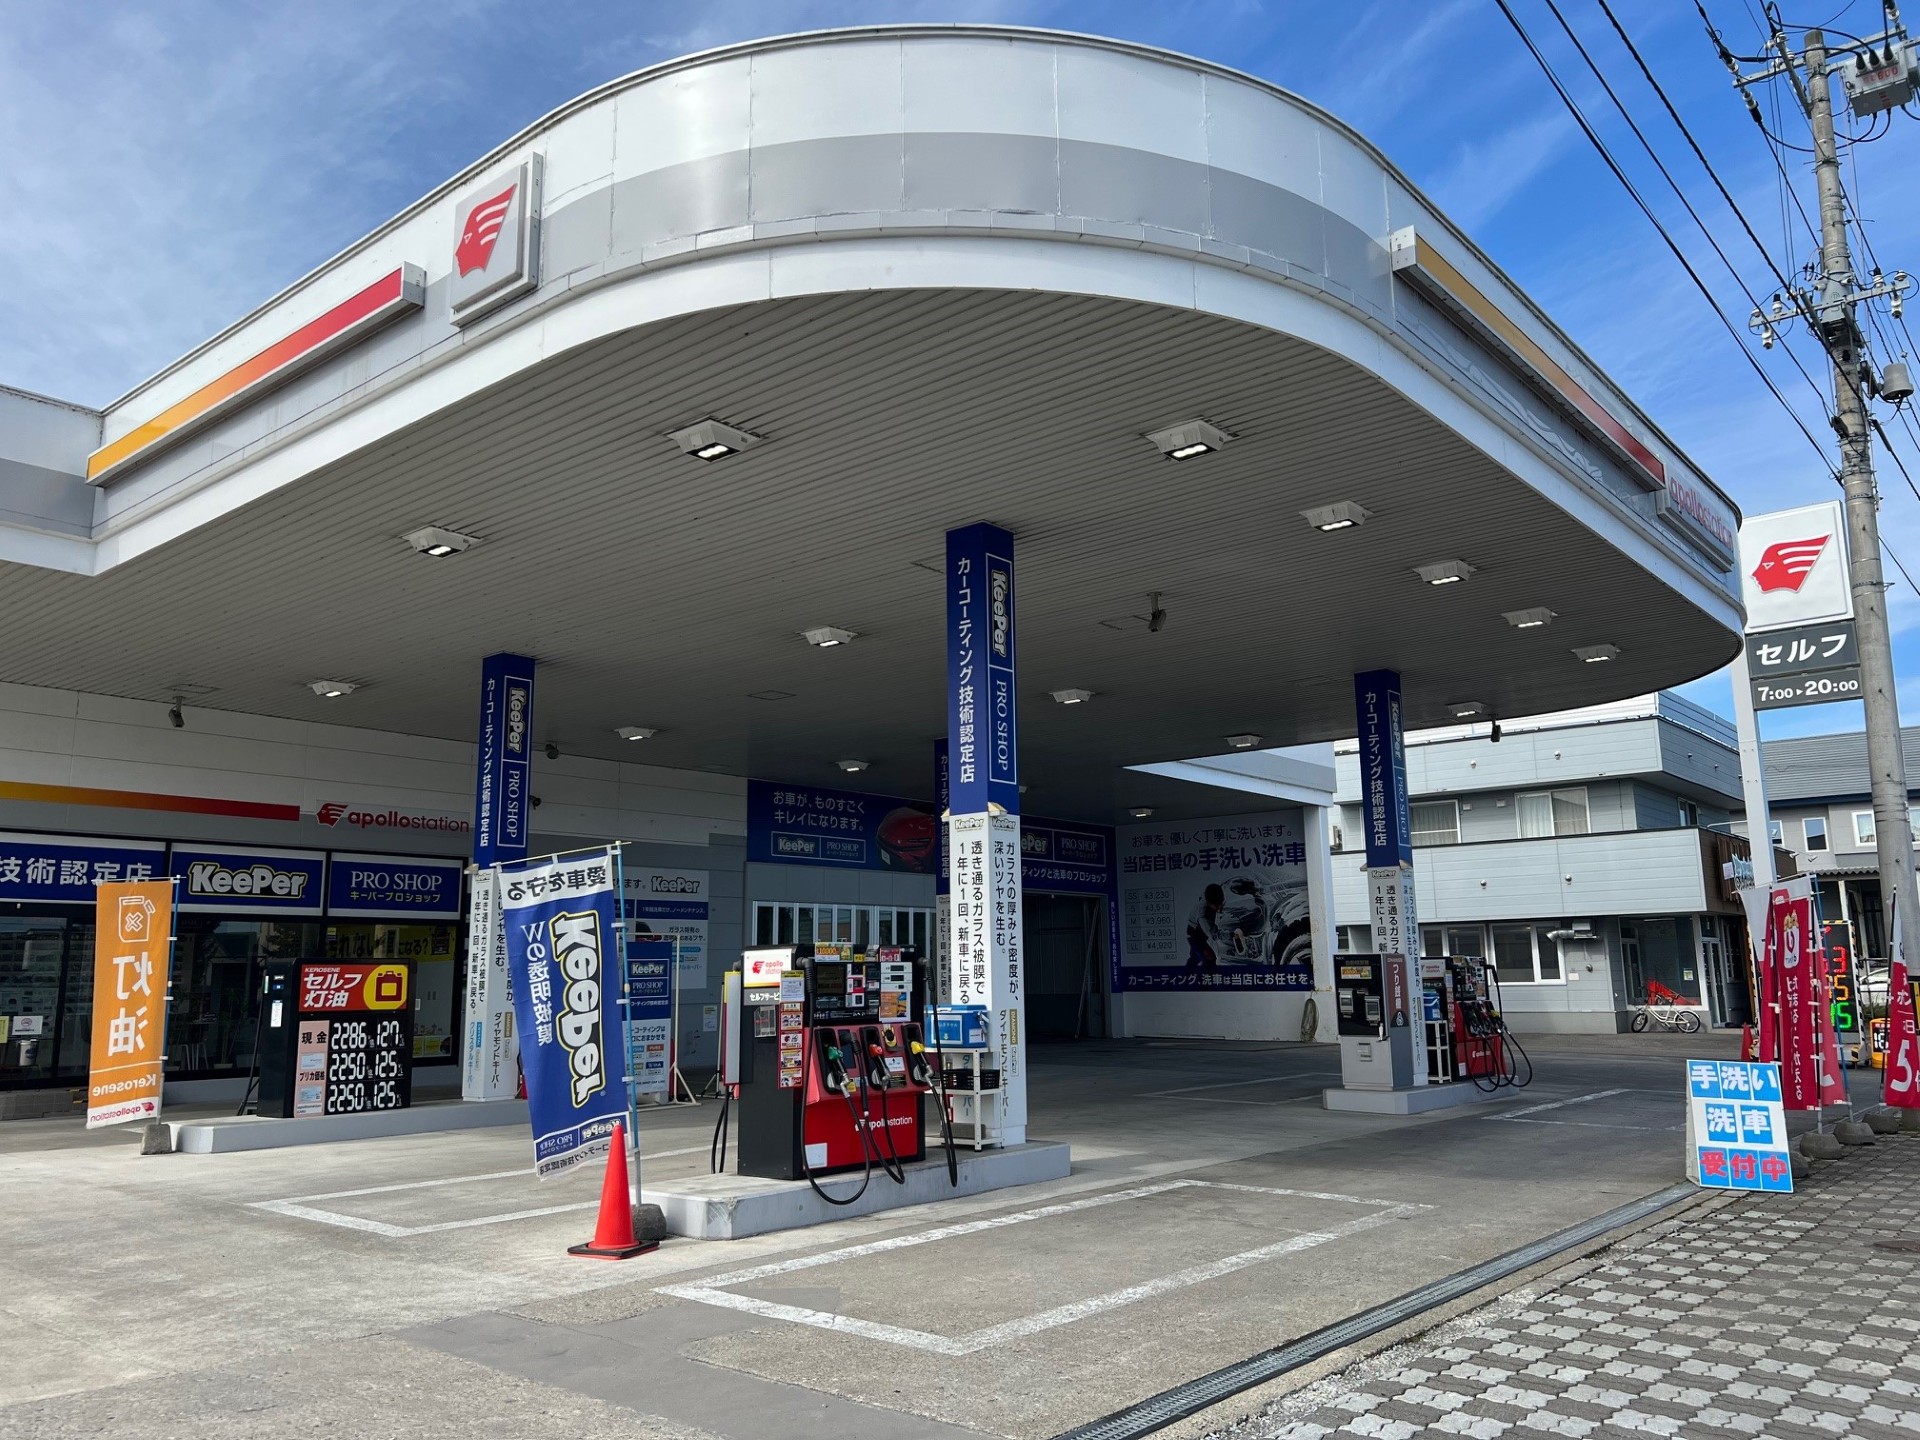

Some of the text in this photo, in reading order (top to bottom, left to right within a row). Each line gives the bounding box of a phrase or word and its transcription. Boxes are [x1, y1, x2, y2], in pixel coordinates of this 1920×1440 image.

[991, 569, 1008, 658] KeePer
[1756, 634, 1847, 666] セルフ
[958, 557, 974, 783] カーコーティング技術認定店
[1758, 679, 1858, 702] 7:00 20:00
[507, 687, 527, 754] KeePer
[996, 680, 1008, 771] PRO SHOP
[480, 678, 495, 847] カーコーティング技術認定店
[1365, 691, 1387, 847] カーコーティング技術認定店
[507, 769, 520, 838] PRO SHOP
[773, 791, 865, 814] お車が、ものすごく
[347, 811, 470, 833] apollostation
[774, 810, 864, 832] キレイになります。
[954, 818, 984, 830] KeePer
[777, 836, 815, 853] KeePer
[1132, 824, 1292, 848] お車を、優しく丁寧に洗います。
[1123, 842, 1306, 873] 当店自慢の手洗い洗車
[188, 862, 307, 899] KeePer
[350, 871, 442, 892] PRO SHOP
[651, 876, 700, 893] KeePer
[994, 841, 1006, 954] 深いツヤを生む。
[971, 841, 986, 994] 透き通るガラス被膜で
[1006, 842, 1018, 1001] ガラスの厚みと密度が、
[304, 973, 362, 990] セルフ
[632, 964, 664, 975] KeePer
[1128, 973, 1315, 986] カーコーティング、洗車は当店にお任せを。
[304, 990, 349, 1008] 灯油
[302, 1031, 327, 1044] 現金
[331, 1022, 367, 1050] 2286
[377, 1021, 400, 1047] 127
[300, 1071, 325, 1081] プリカ価格
[329, 1052, 366, 1081] 2250
[375, 1050, 398, 1077] 125
[1691, 1065, 1778, 1091] 手洗い
[327, 1083, 364, 1112] 2250
[374, 1080, 396, 1107] 125
[1707, 1107, 1770, 1135] 洗車
[1701, 1151, 1788, 1182] 受付中
